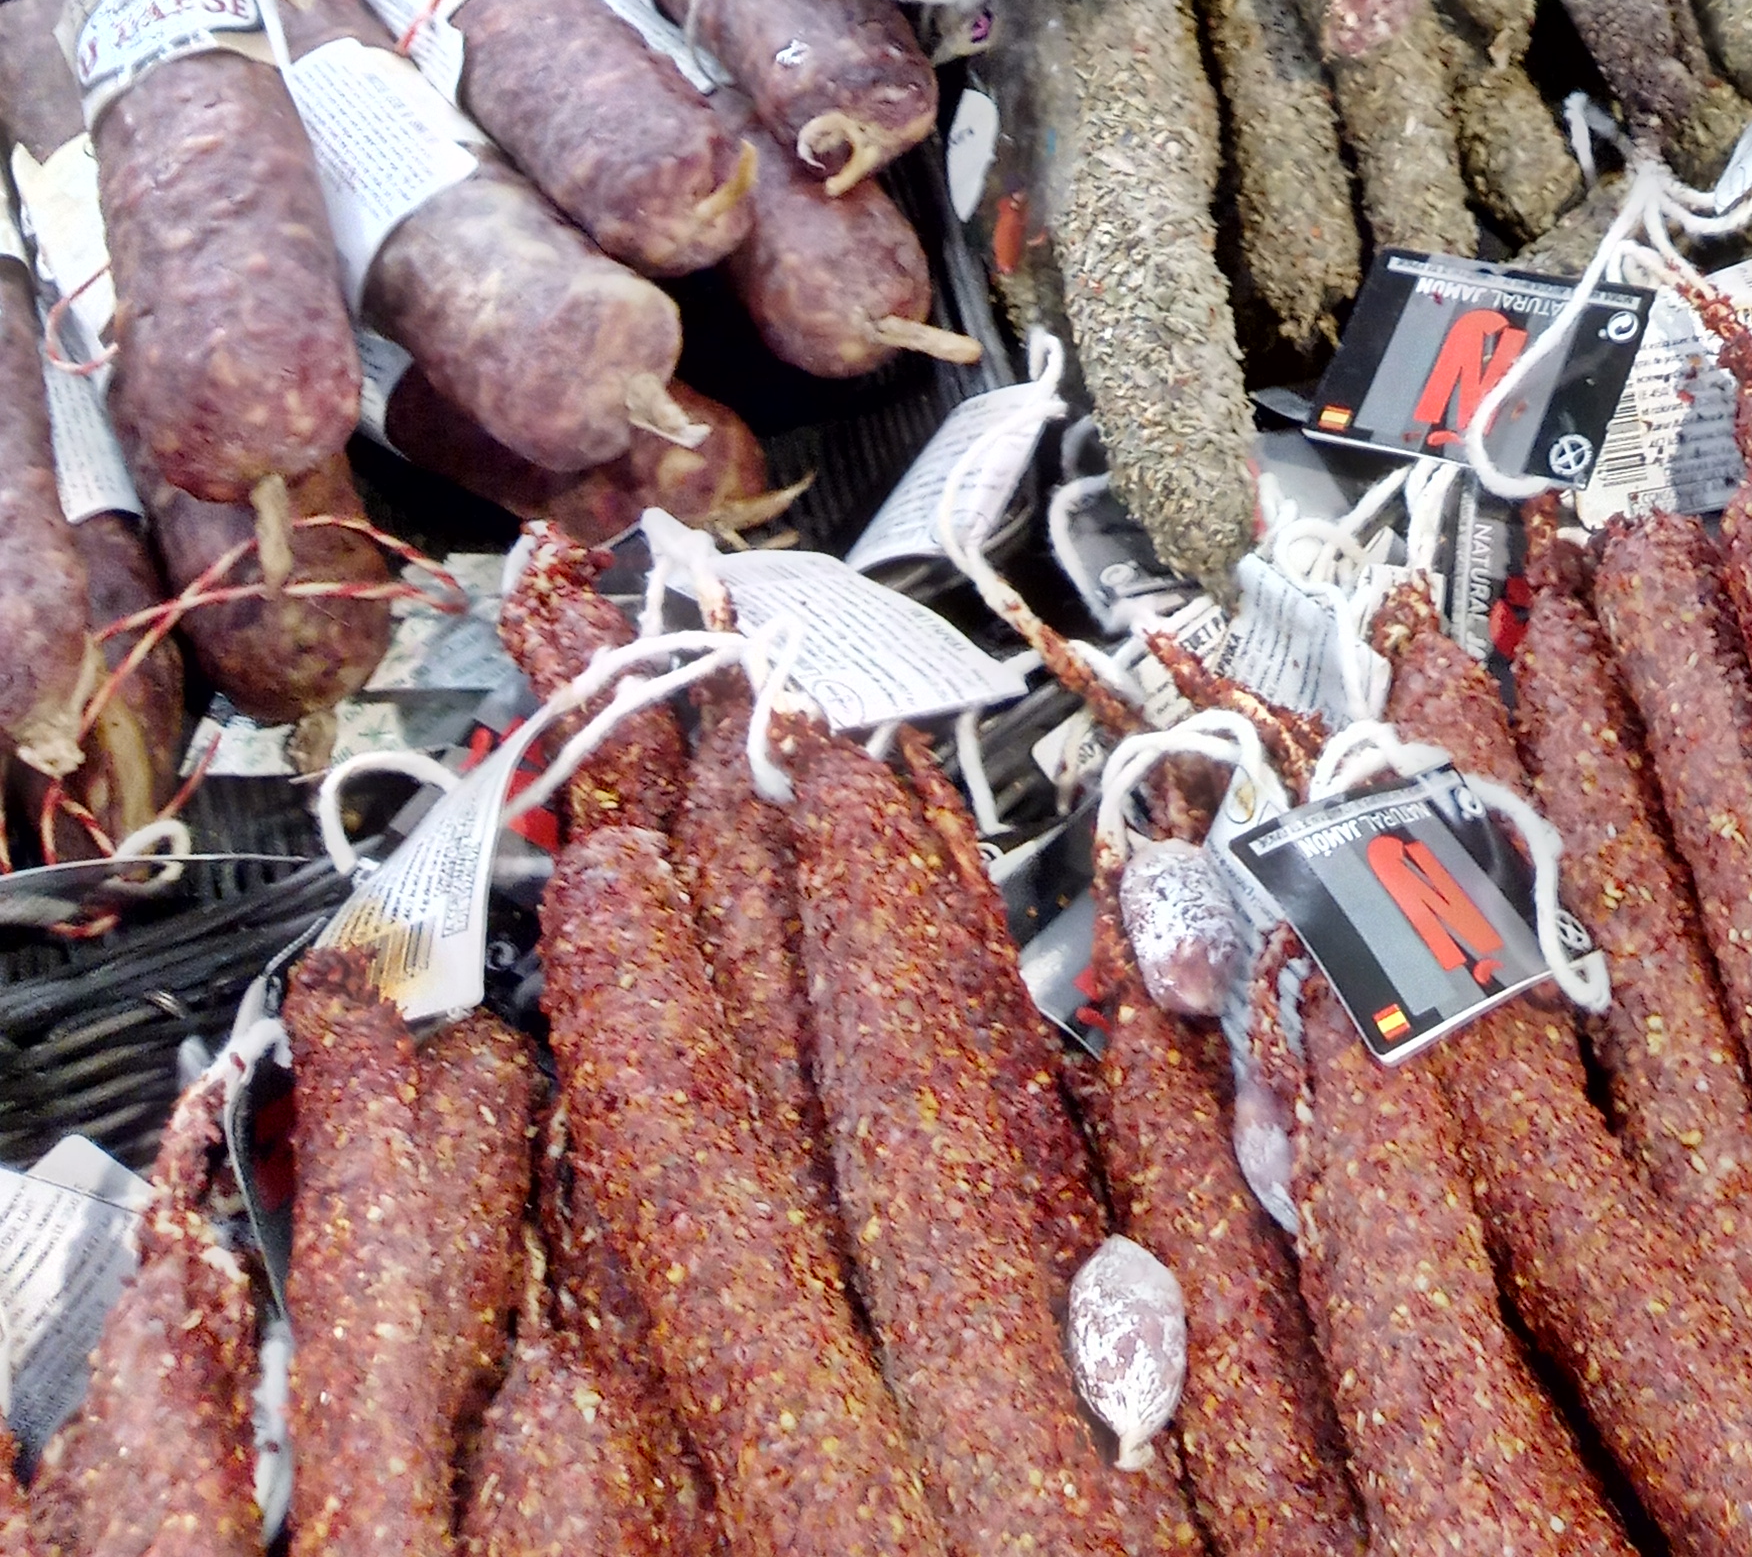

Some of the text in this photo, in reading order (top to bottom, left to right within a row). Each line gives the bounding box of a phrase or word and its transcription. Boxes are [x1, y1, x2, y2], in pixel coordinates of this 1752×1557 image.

[1467, 523, 1495, 625] NATURAL
[1296, 797, 1431, 863] NATURAL JAMÓN
